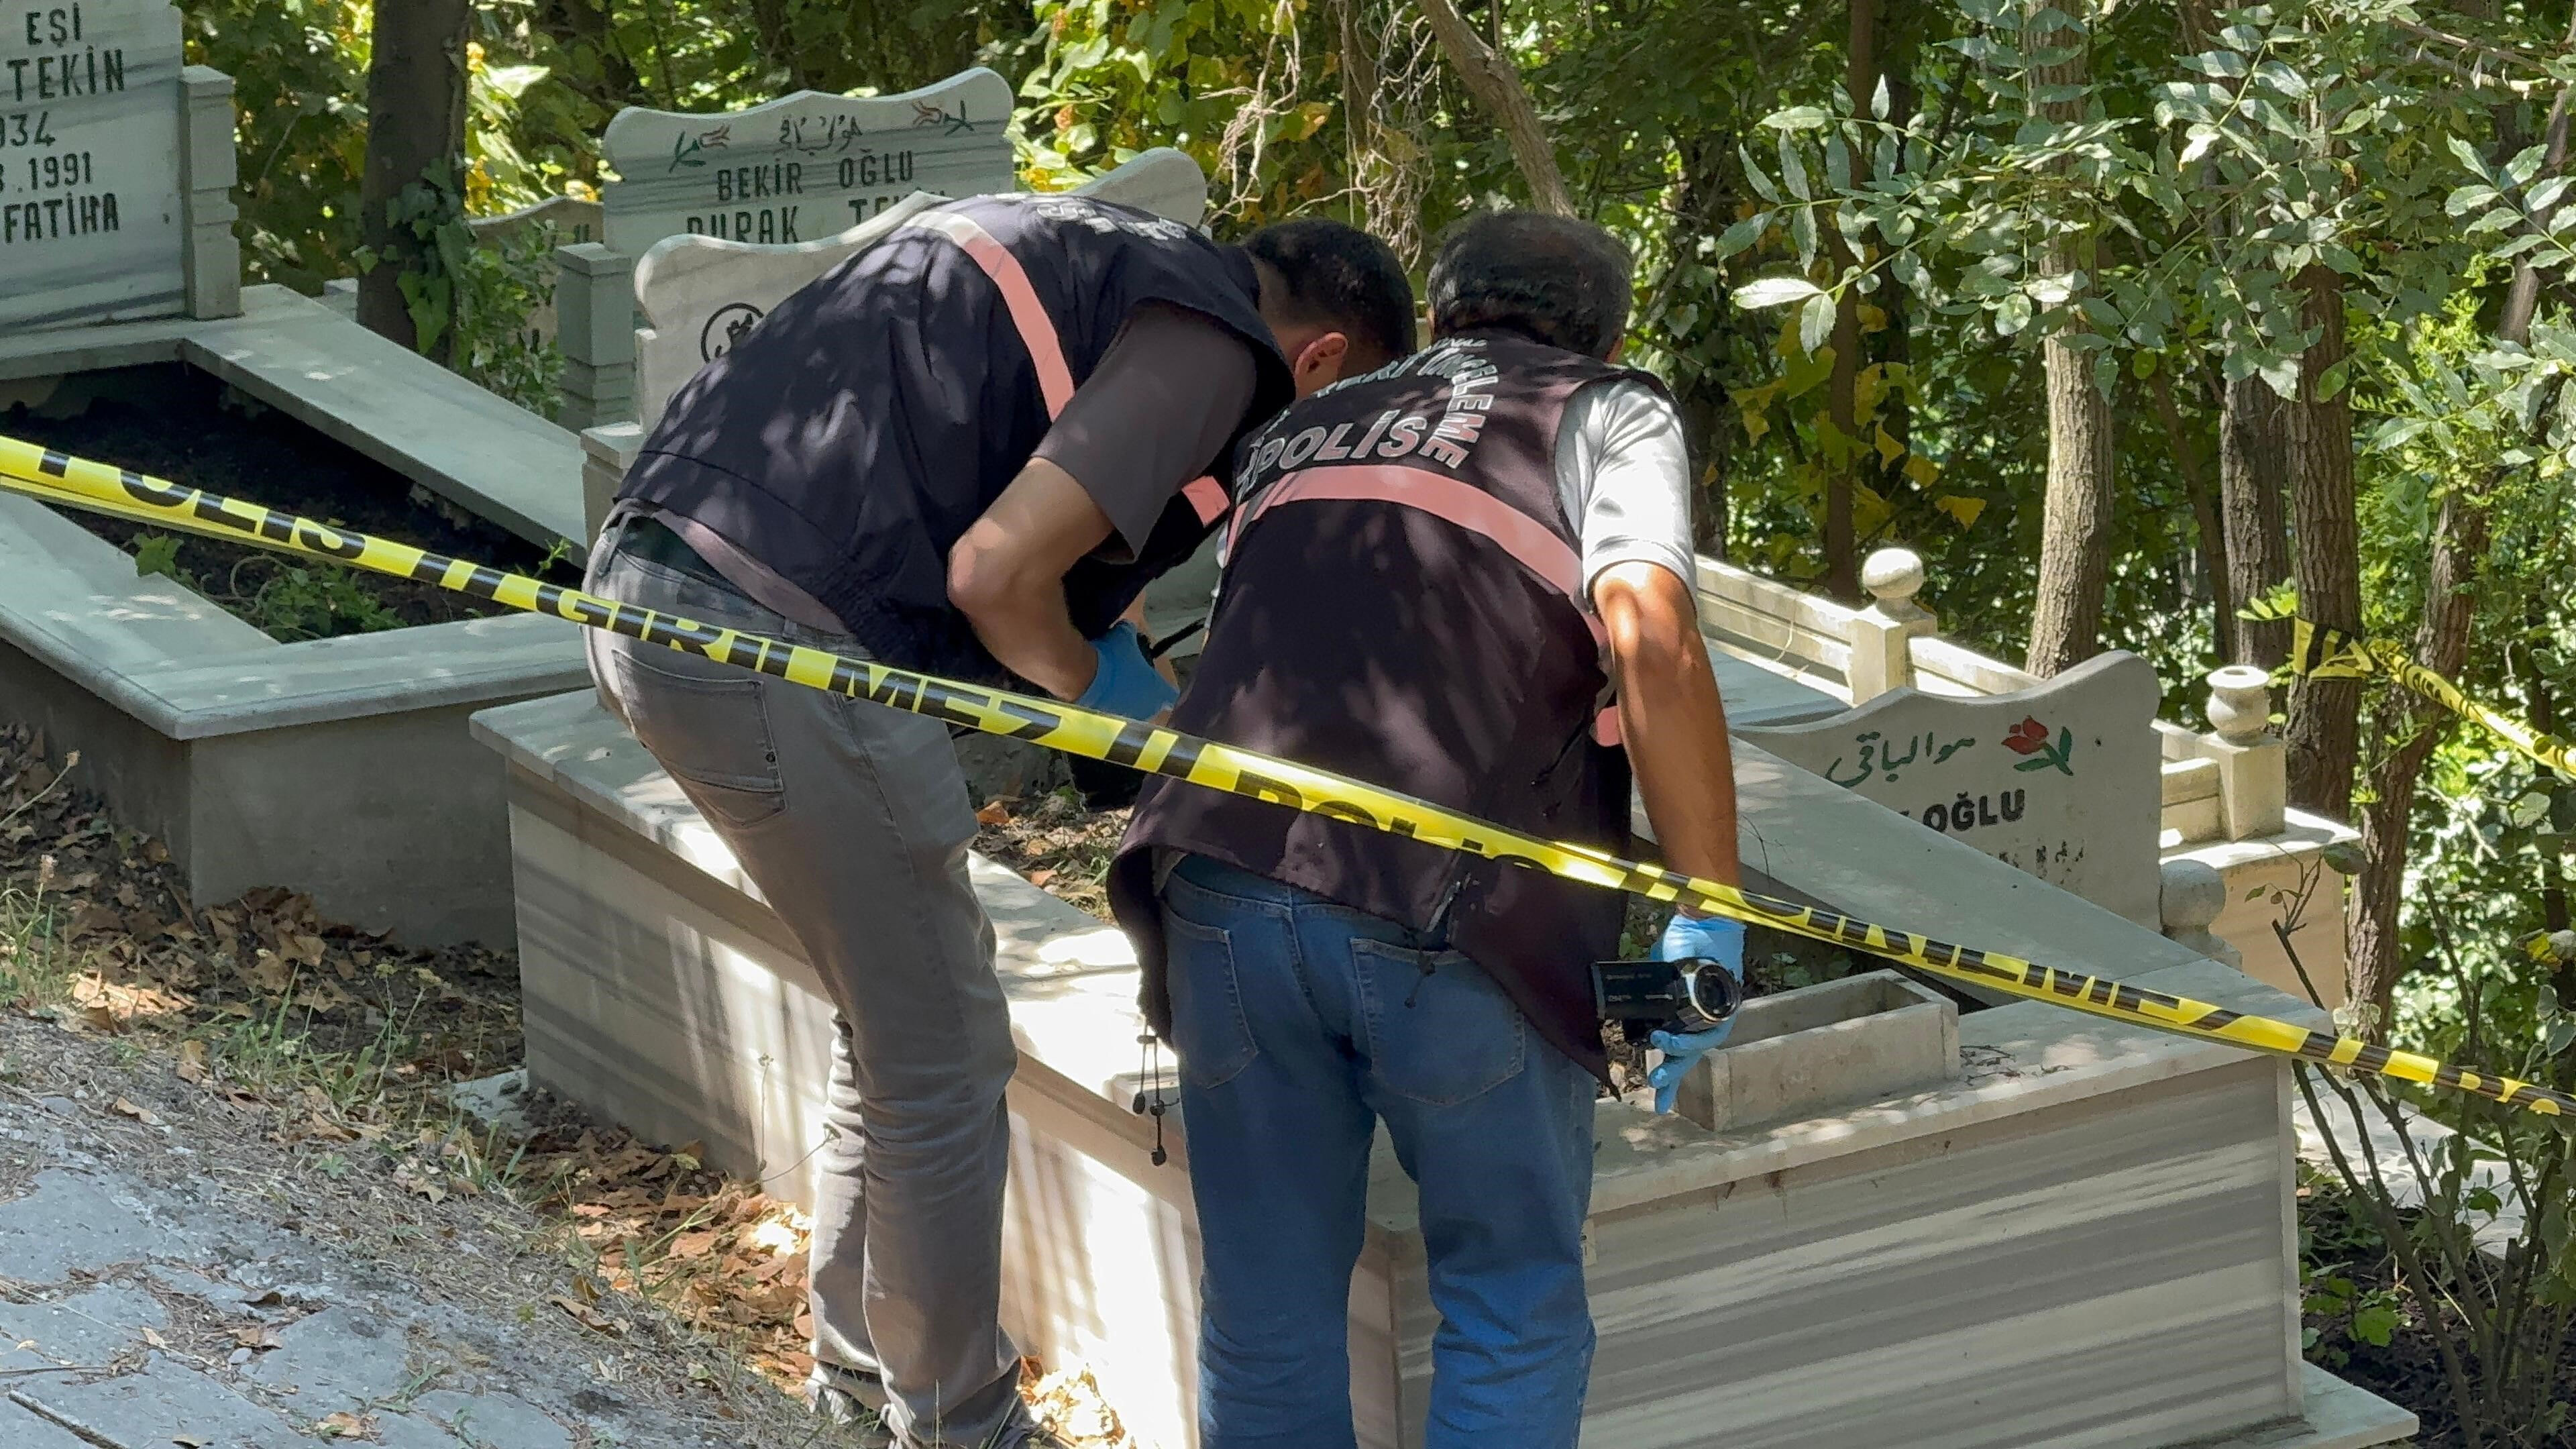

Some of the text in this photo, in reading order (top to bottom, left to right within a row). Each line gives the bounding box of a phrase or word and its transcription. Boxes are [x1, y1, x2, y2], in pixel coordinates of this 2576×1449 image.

[6, 45, 125, 101] TEKİN
[717, 148, 913, 201] BEKİR OĞLU
[4, 192, 120, 244] FATİHA
[1246, 409, 1428, 492] POLİS
[1923, 788, 2025, 833] OĞLU
